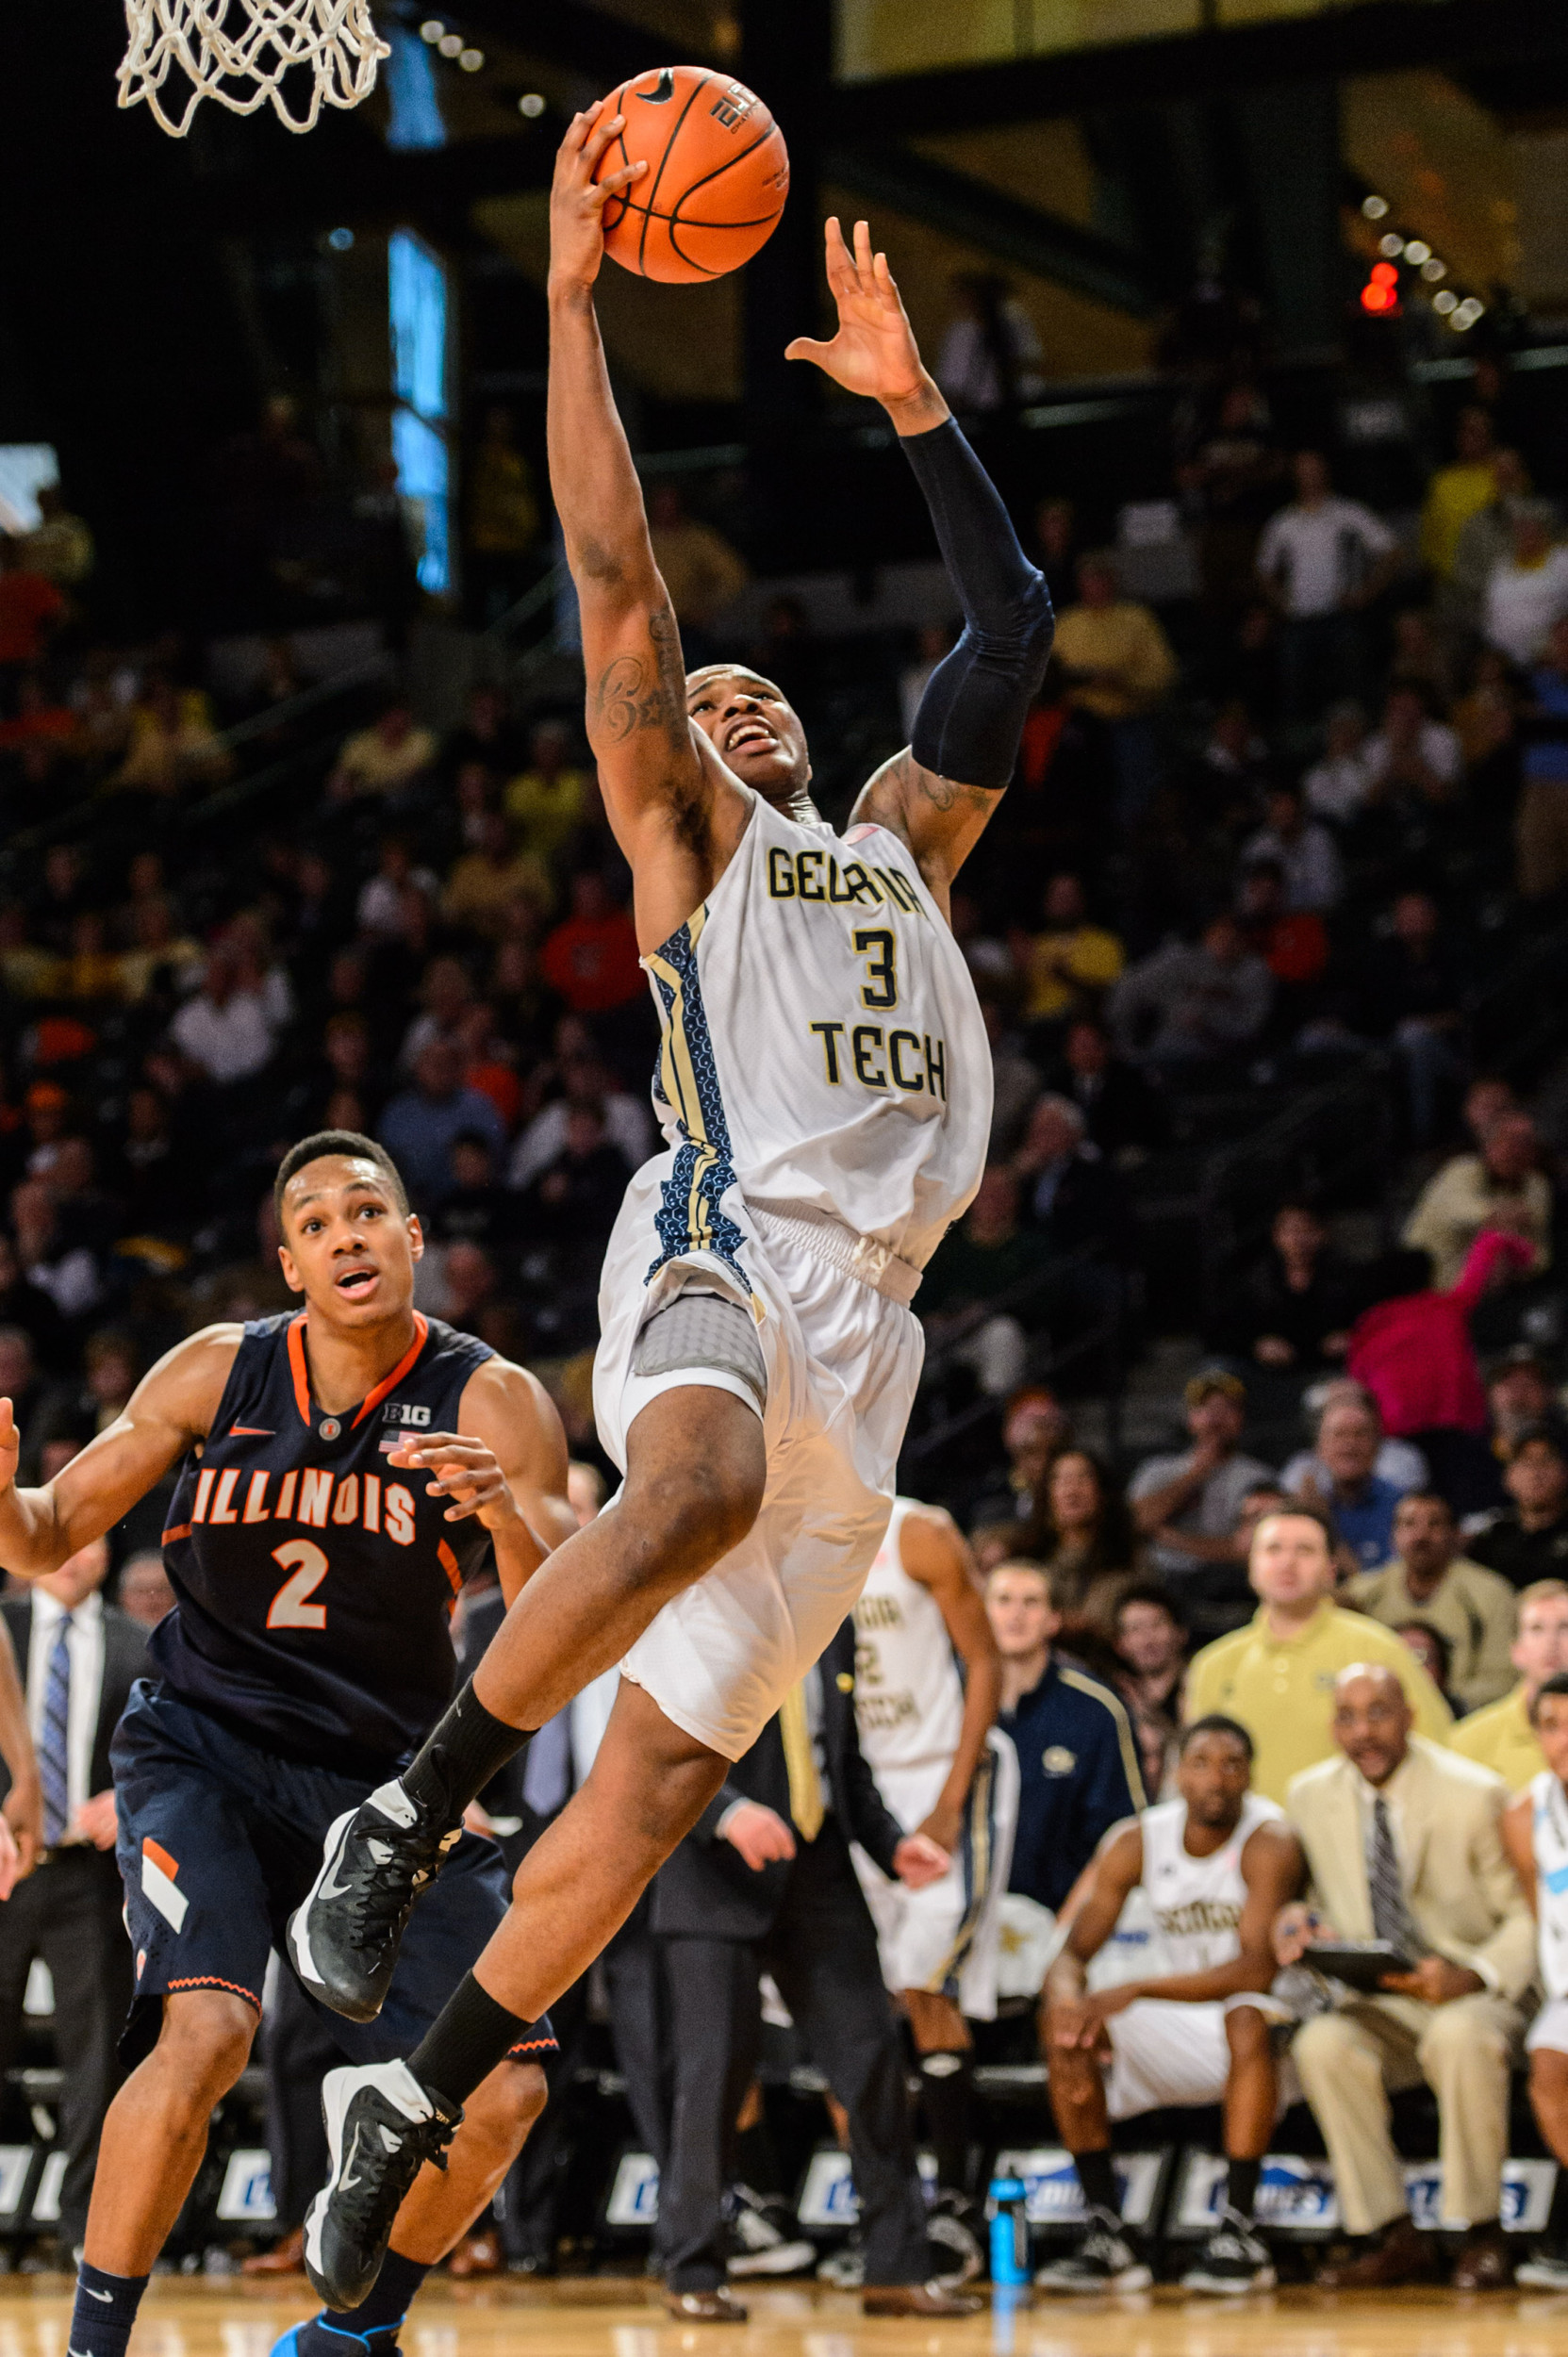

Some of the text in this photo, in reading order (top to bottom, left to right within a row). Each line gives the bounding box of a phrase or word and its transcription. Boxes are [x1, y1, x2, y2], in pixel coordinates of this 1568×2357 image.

[852, 928, 898, 1011] 3
[809, 1021, 946, 1102] TECH
[191, 1467, 416, 1546] ILLINOIS
[266, 1538, 329, 1630] 2
